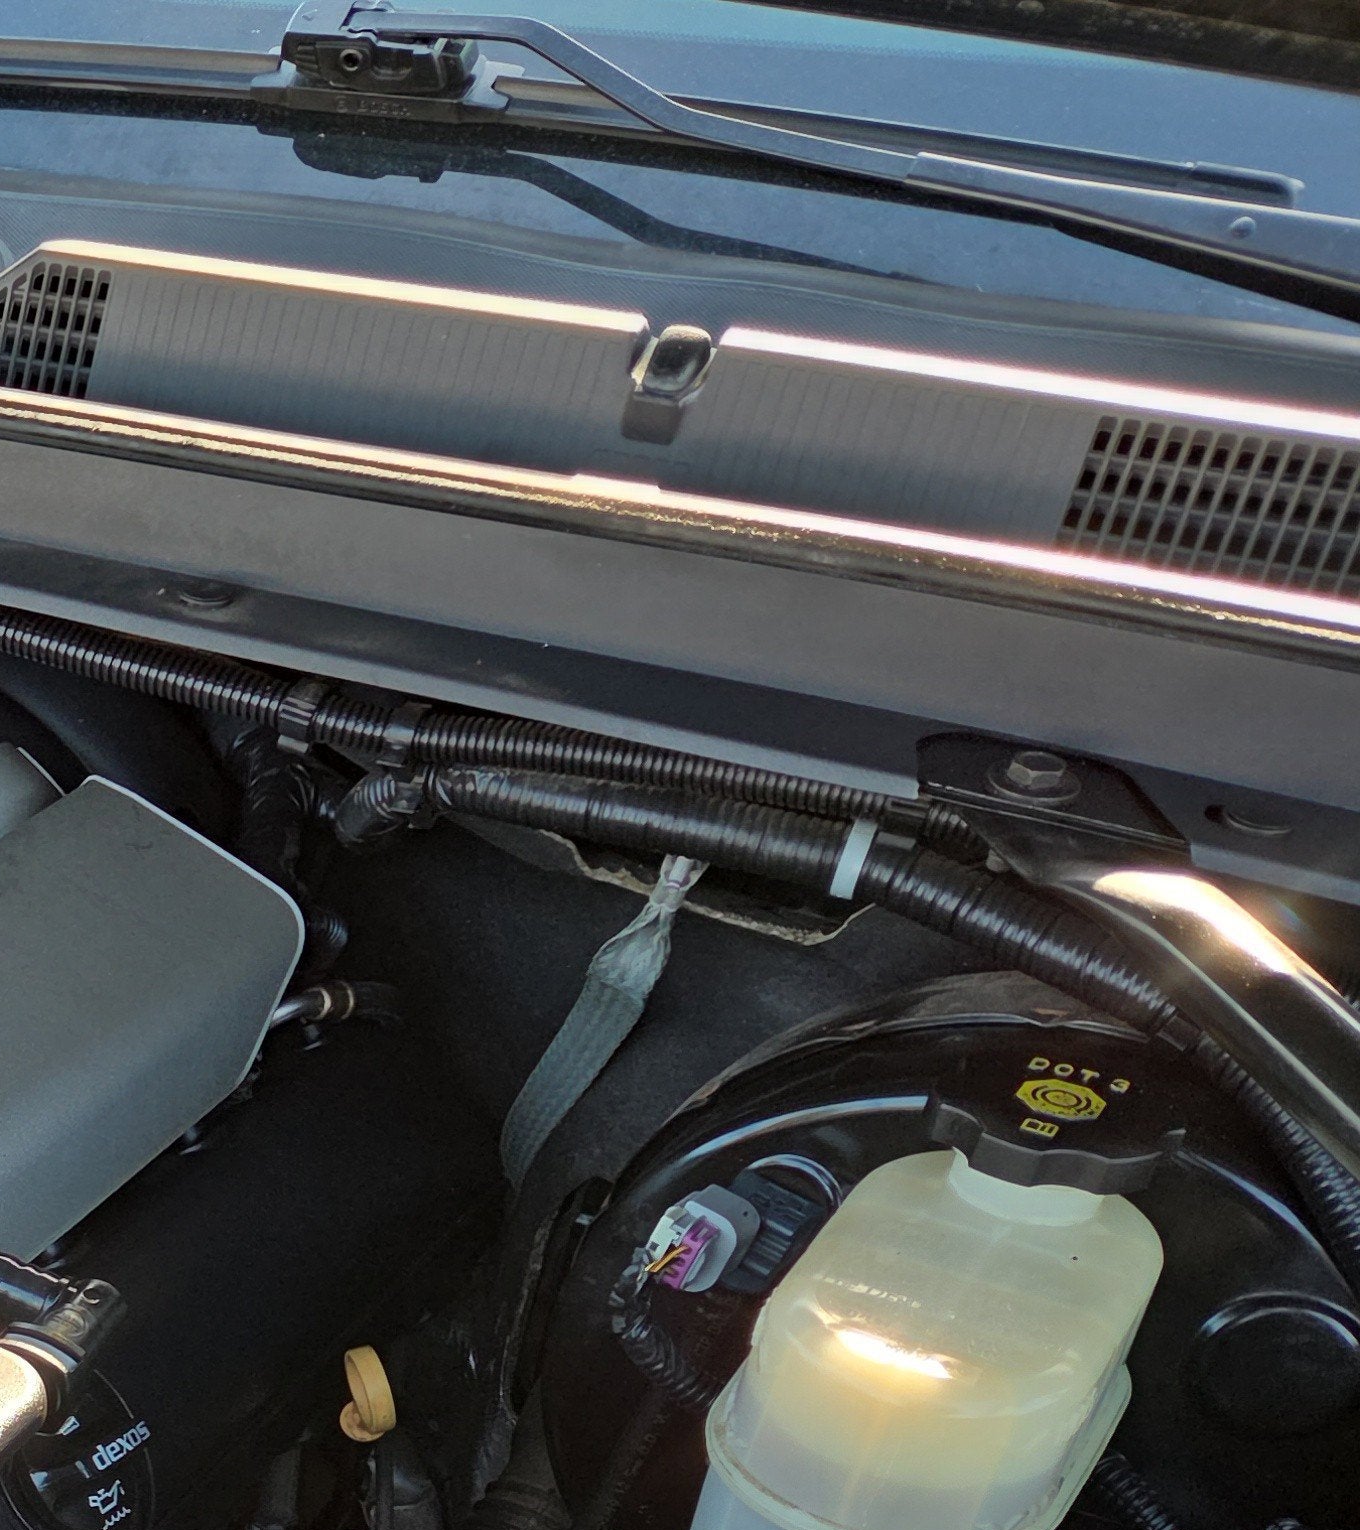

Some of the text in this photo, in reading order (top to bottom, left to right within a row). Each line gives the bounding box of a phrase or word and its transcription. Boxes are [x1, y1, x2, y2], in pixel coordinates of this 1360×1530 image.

[1028, 1056, 1131, 1094] DOT 3
[91, 1420, 151, 1470] dexos
